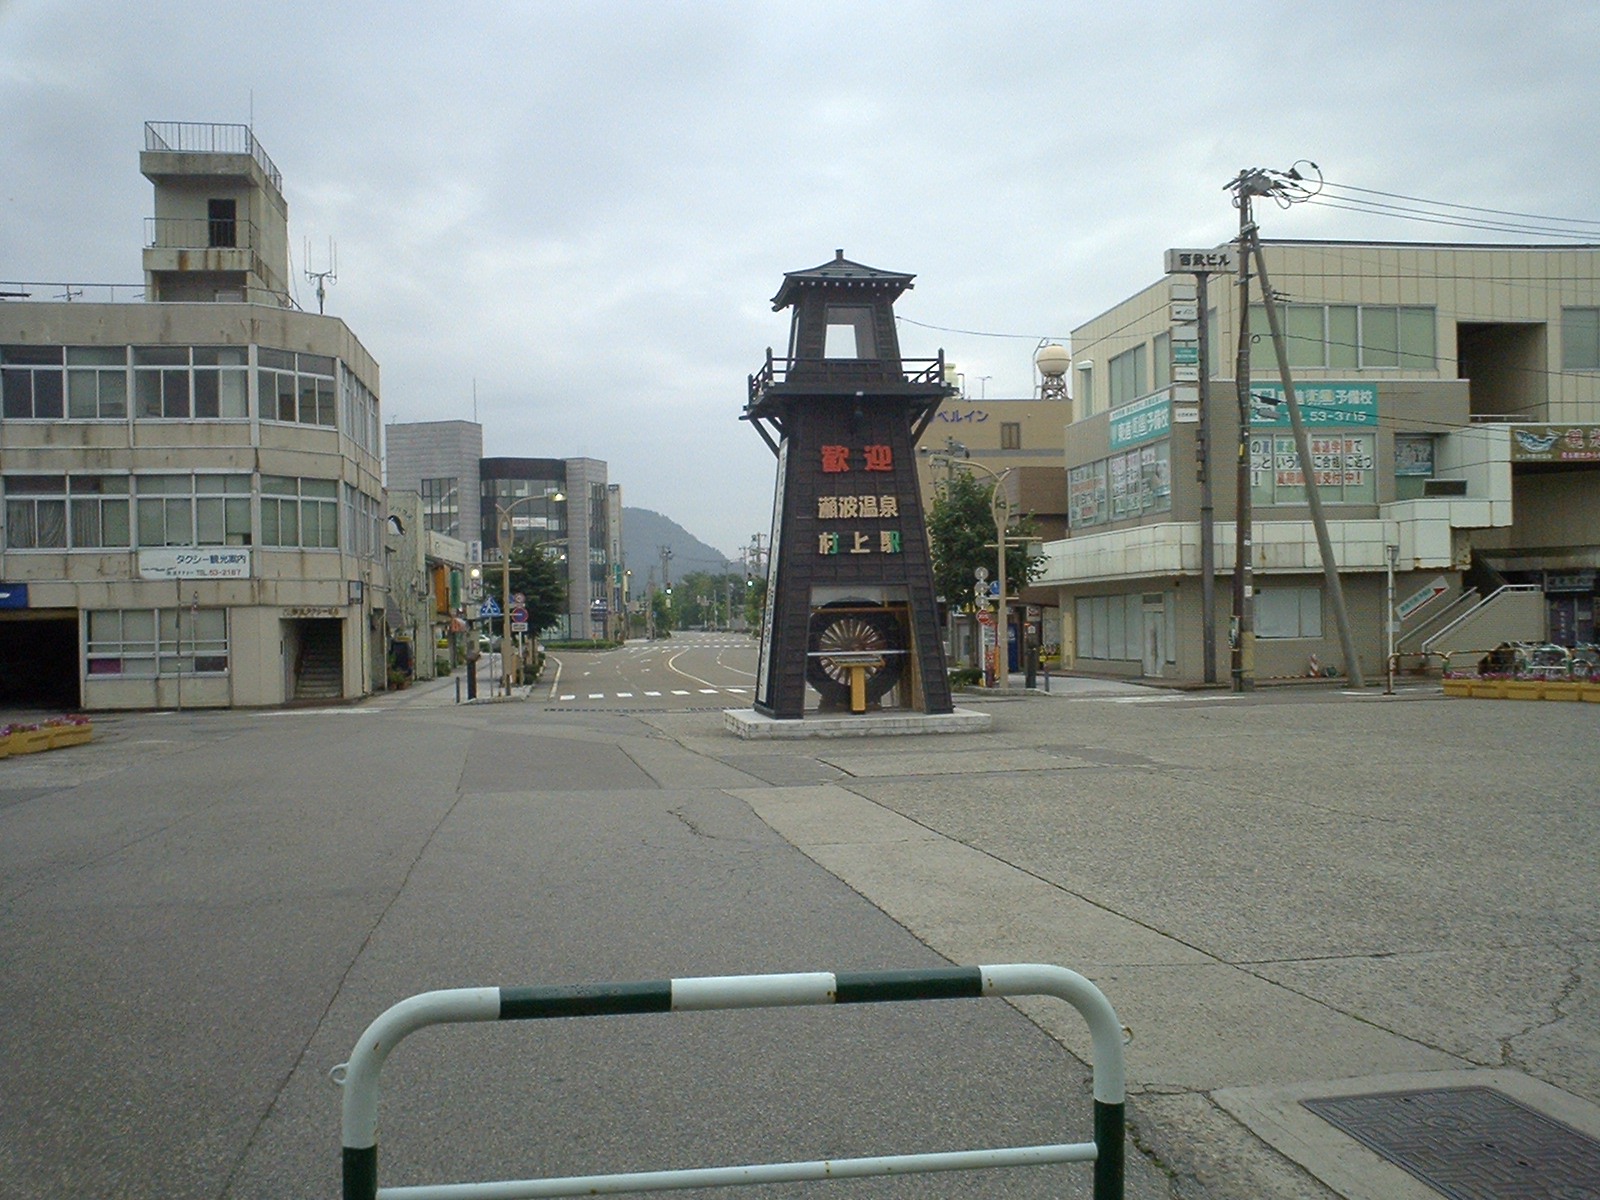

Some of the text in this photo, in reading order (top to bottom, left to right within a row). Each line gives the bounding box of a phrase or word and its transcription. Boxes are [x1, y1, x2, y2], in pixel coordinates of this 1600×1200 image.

[930, 410, 989, 423] ベルイン
[818, 495, 899, 518] 瀬波温泉
[819, 531, 900, 555] 村上駅
